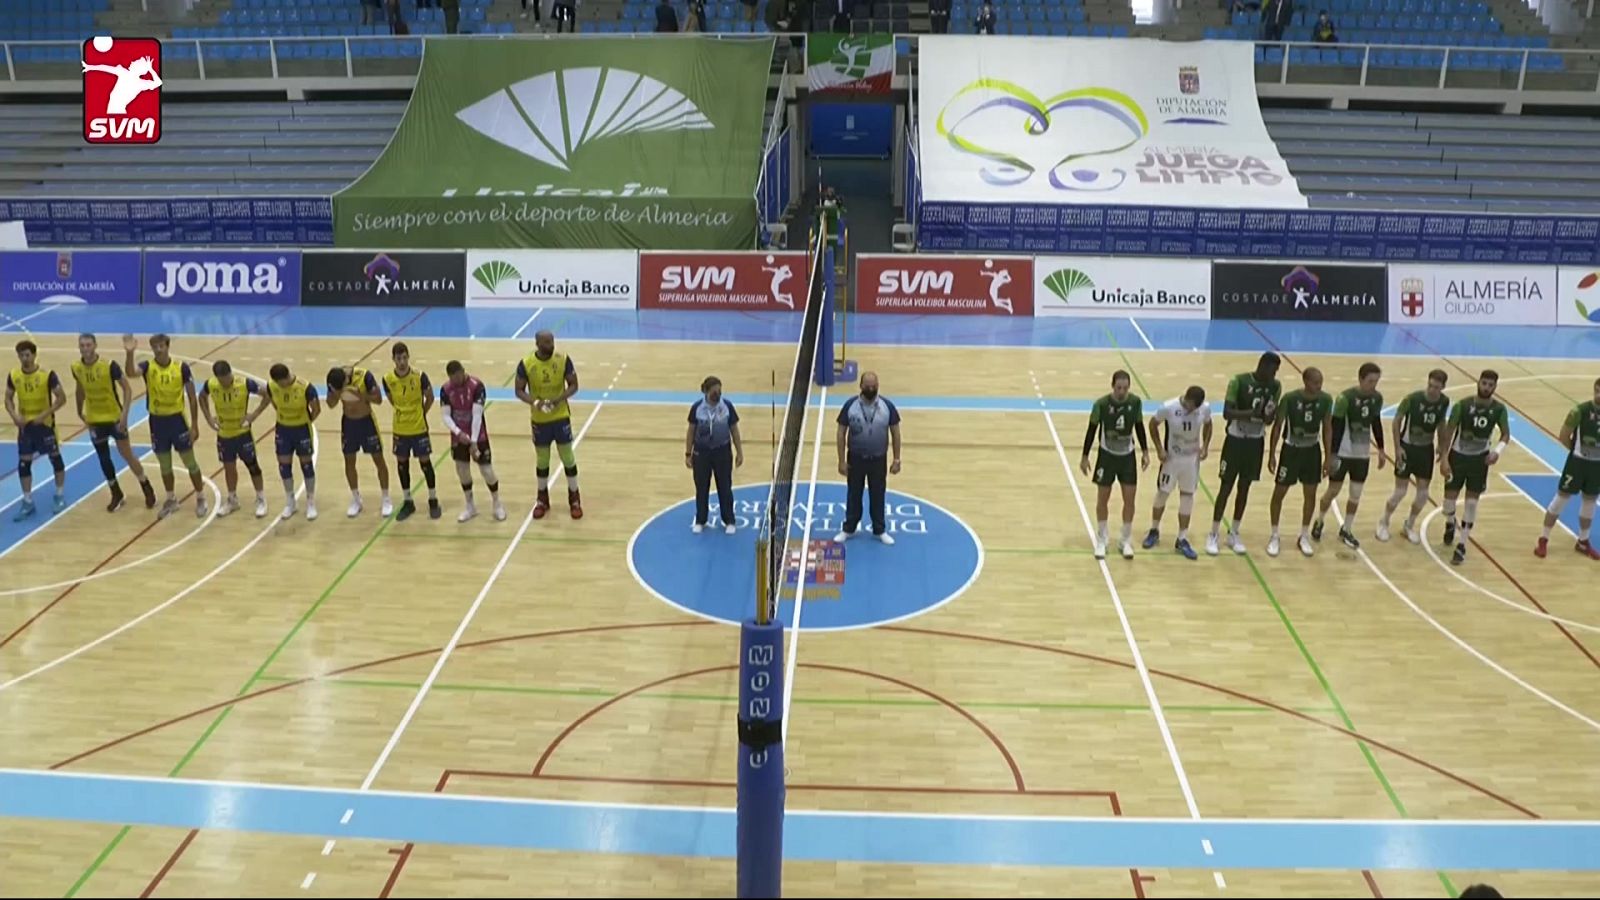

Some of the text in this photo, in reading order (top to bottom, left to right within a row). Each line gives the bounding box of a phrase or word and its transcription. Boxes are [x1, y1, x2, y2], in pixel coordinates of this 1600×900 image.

[1135, 153, 1271, 171] JUEGA
[1135, 169, 1283, 186] LIMPIO
[352, 212, 440, 234] Siempre
[443, 208, 486, 224] con
[489, 201, 513, 221] el
[515, 202, 600, 228] deporte
[604, 203, 634, 222] de
[393, 277, 456, 291] ALMERÍA
[660, 265, 736, 290] SVM
[878, 269, 954, 295] SVM
[66, 282, 77, 291] DE
[519, 278, 630, 297] Unicaja Banco
[1445, 276, 1543, 300] ALMERÍA
[658, 293, 768, 304] SUPERLIGA VOLEIBOL MASCULINA
[875, 296, 987, 309] SUPERLIGA VOLEIBOL MASCULINA
[1092, 288, 1206, 307] Unicaja Banco
[1312, 293, 1377, 306] ALMERÍA
[1444, 302, 1495, 315] CIUDAD
[222, 392, 232, 403] 11
[1361, 405, 1369, 417] 3
[1115, 414, 1125, 430] 4
[1423, 412, 1436, 424] 13
[1473, 416, 1488, 428] 10
[1182, 420, 1192, 432] 11
[1161, 473, 1171, 485] 11
[1564, 474, 1573, 485] 7
[748, 644, 774, 769] MONO
